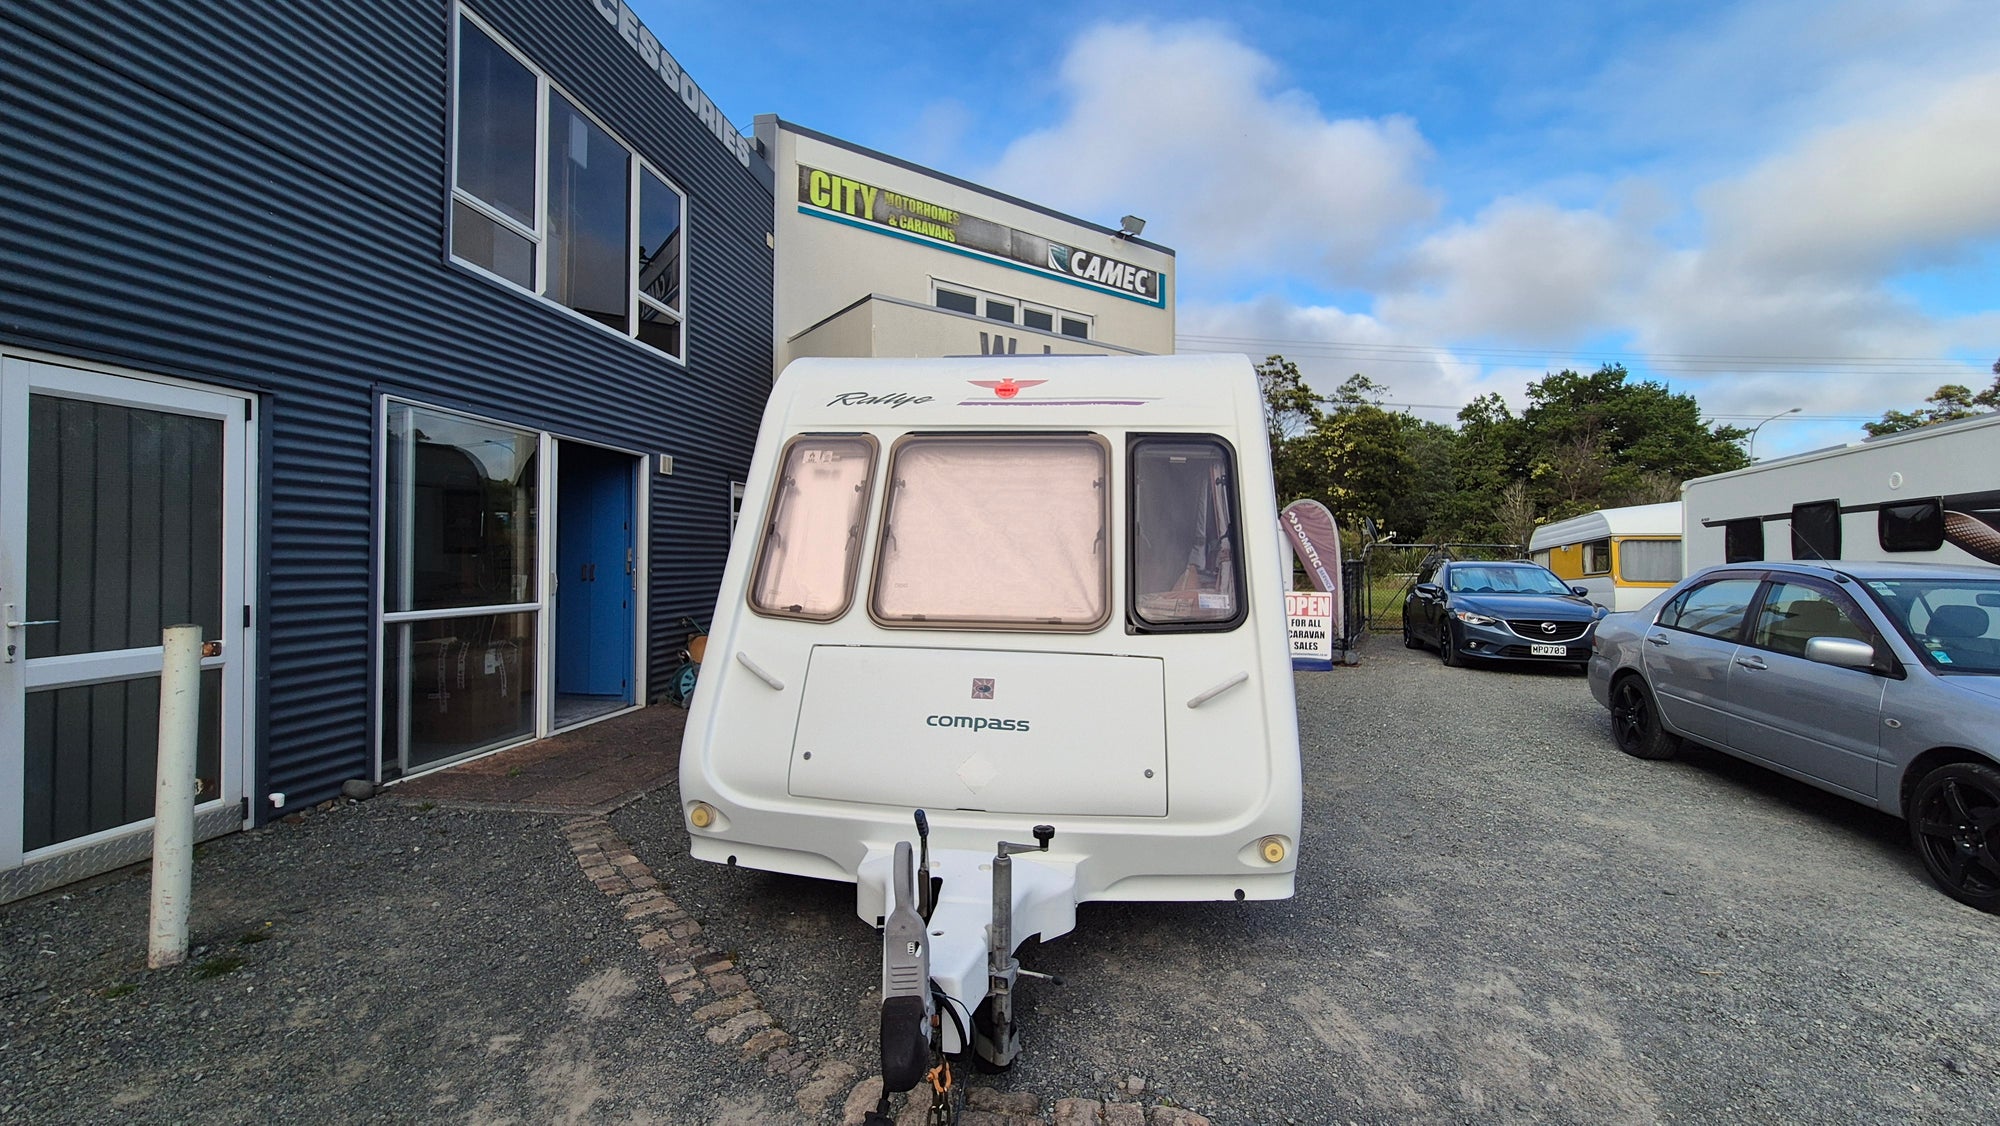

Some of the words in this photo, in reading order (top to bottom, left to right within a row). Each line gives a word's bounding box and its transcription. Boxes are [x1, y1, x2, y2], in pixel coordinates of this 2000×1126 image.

[809, 170, 879, 221] CITY
[884, 192, 960, 226] MOTORHOMES
[888, 214, 898, 227] &
[899, 215, 957, 243] CARAVANS
[1071, 251, 1147, 293] CAMEC
[1294, 523, 1322, 568] DOMETIC
[1286, 597, 1329, 616] OPEN
[1291, 619, 1306, 627] FOR
[1308, 619, 1321, 627] ALL
[1294, 641, 1318, 650] SALES
[1532, 646, 1565, 654] MPQ703
[927, 715, 1029, 731] compass
